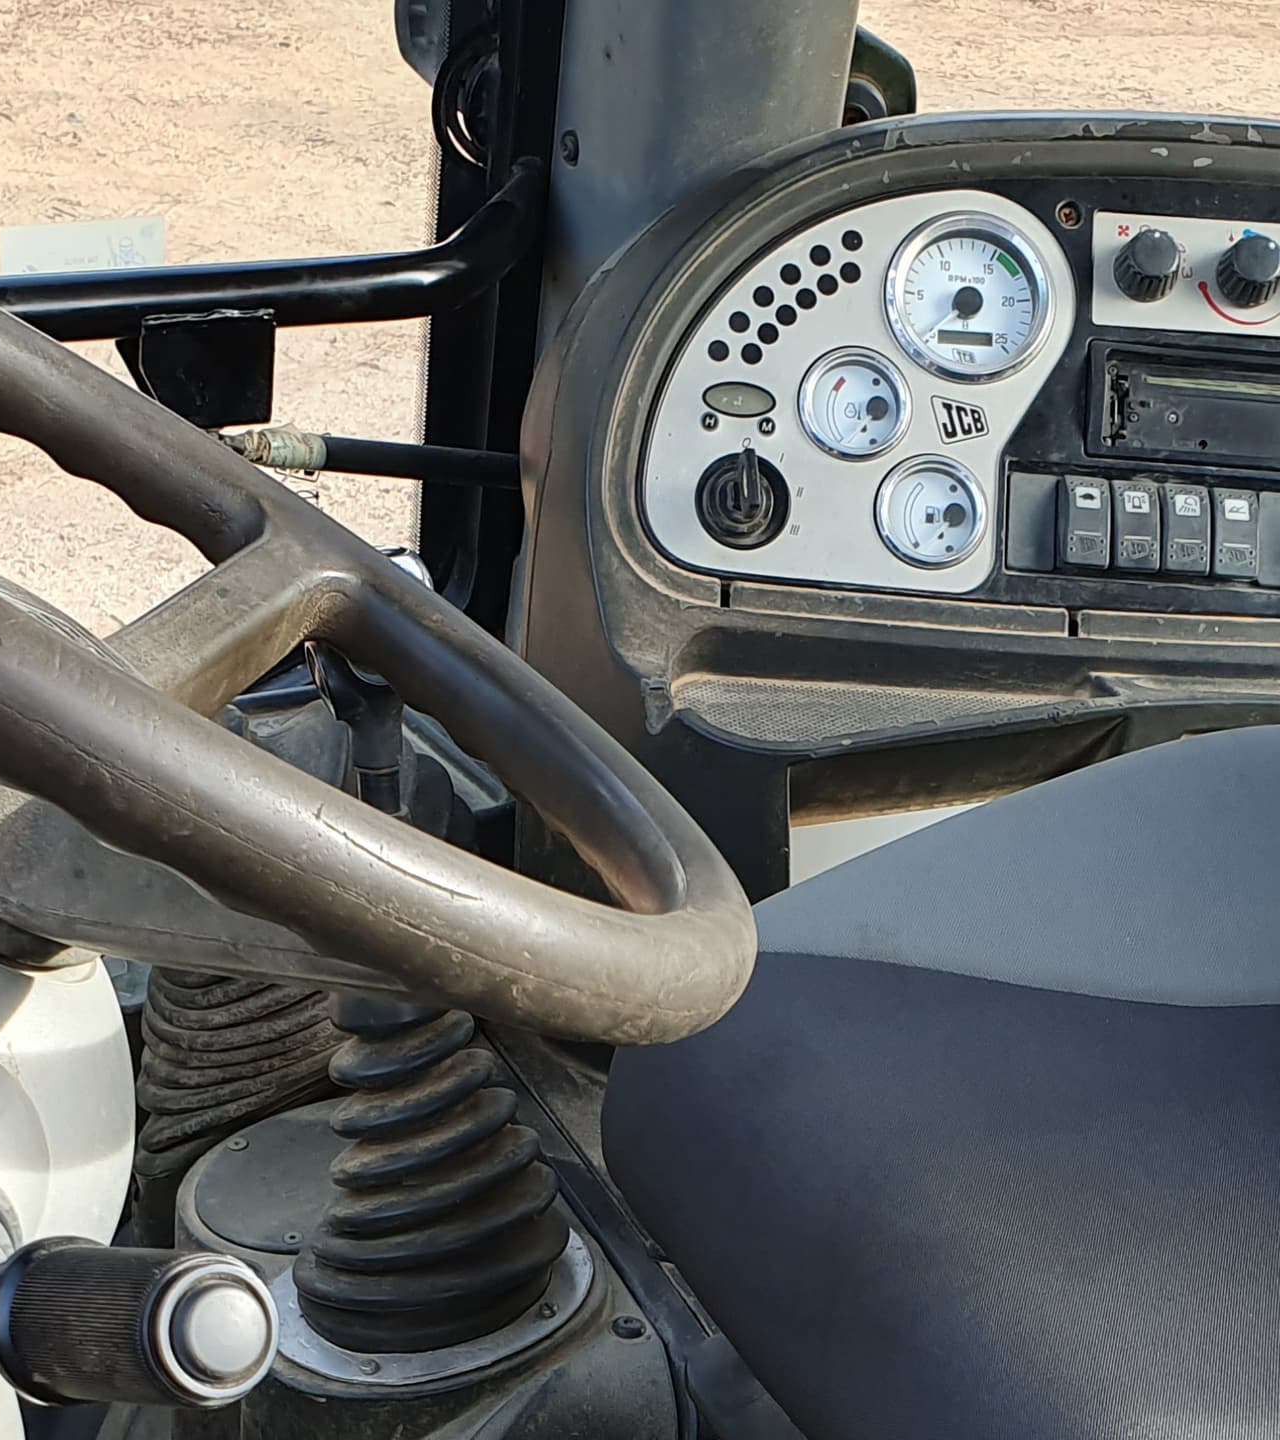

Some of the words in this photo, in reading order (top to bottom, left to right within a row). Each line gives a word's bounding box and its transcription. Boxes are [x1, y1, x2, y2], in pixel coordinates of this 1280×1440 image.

[940, 260, 951, 272] 10
[983, 263, 994, 275] 15
[948, 273, 967, 283] RPM
[917, 289, 924, 300] 5
[1001, 296, 1015, 307] 20
[995, 333, 1008, 344] 25
[705, 416, 715, 427] H
[941, 401, 985, 439] JCB
[761, 422, 772, 432] M
